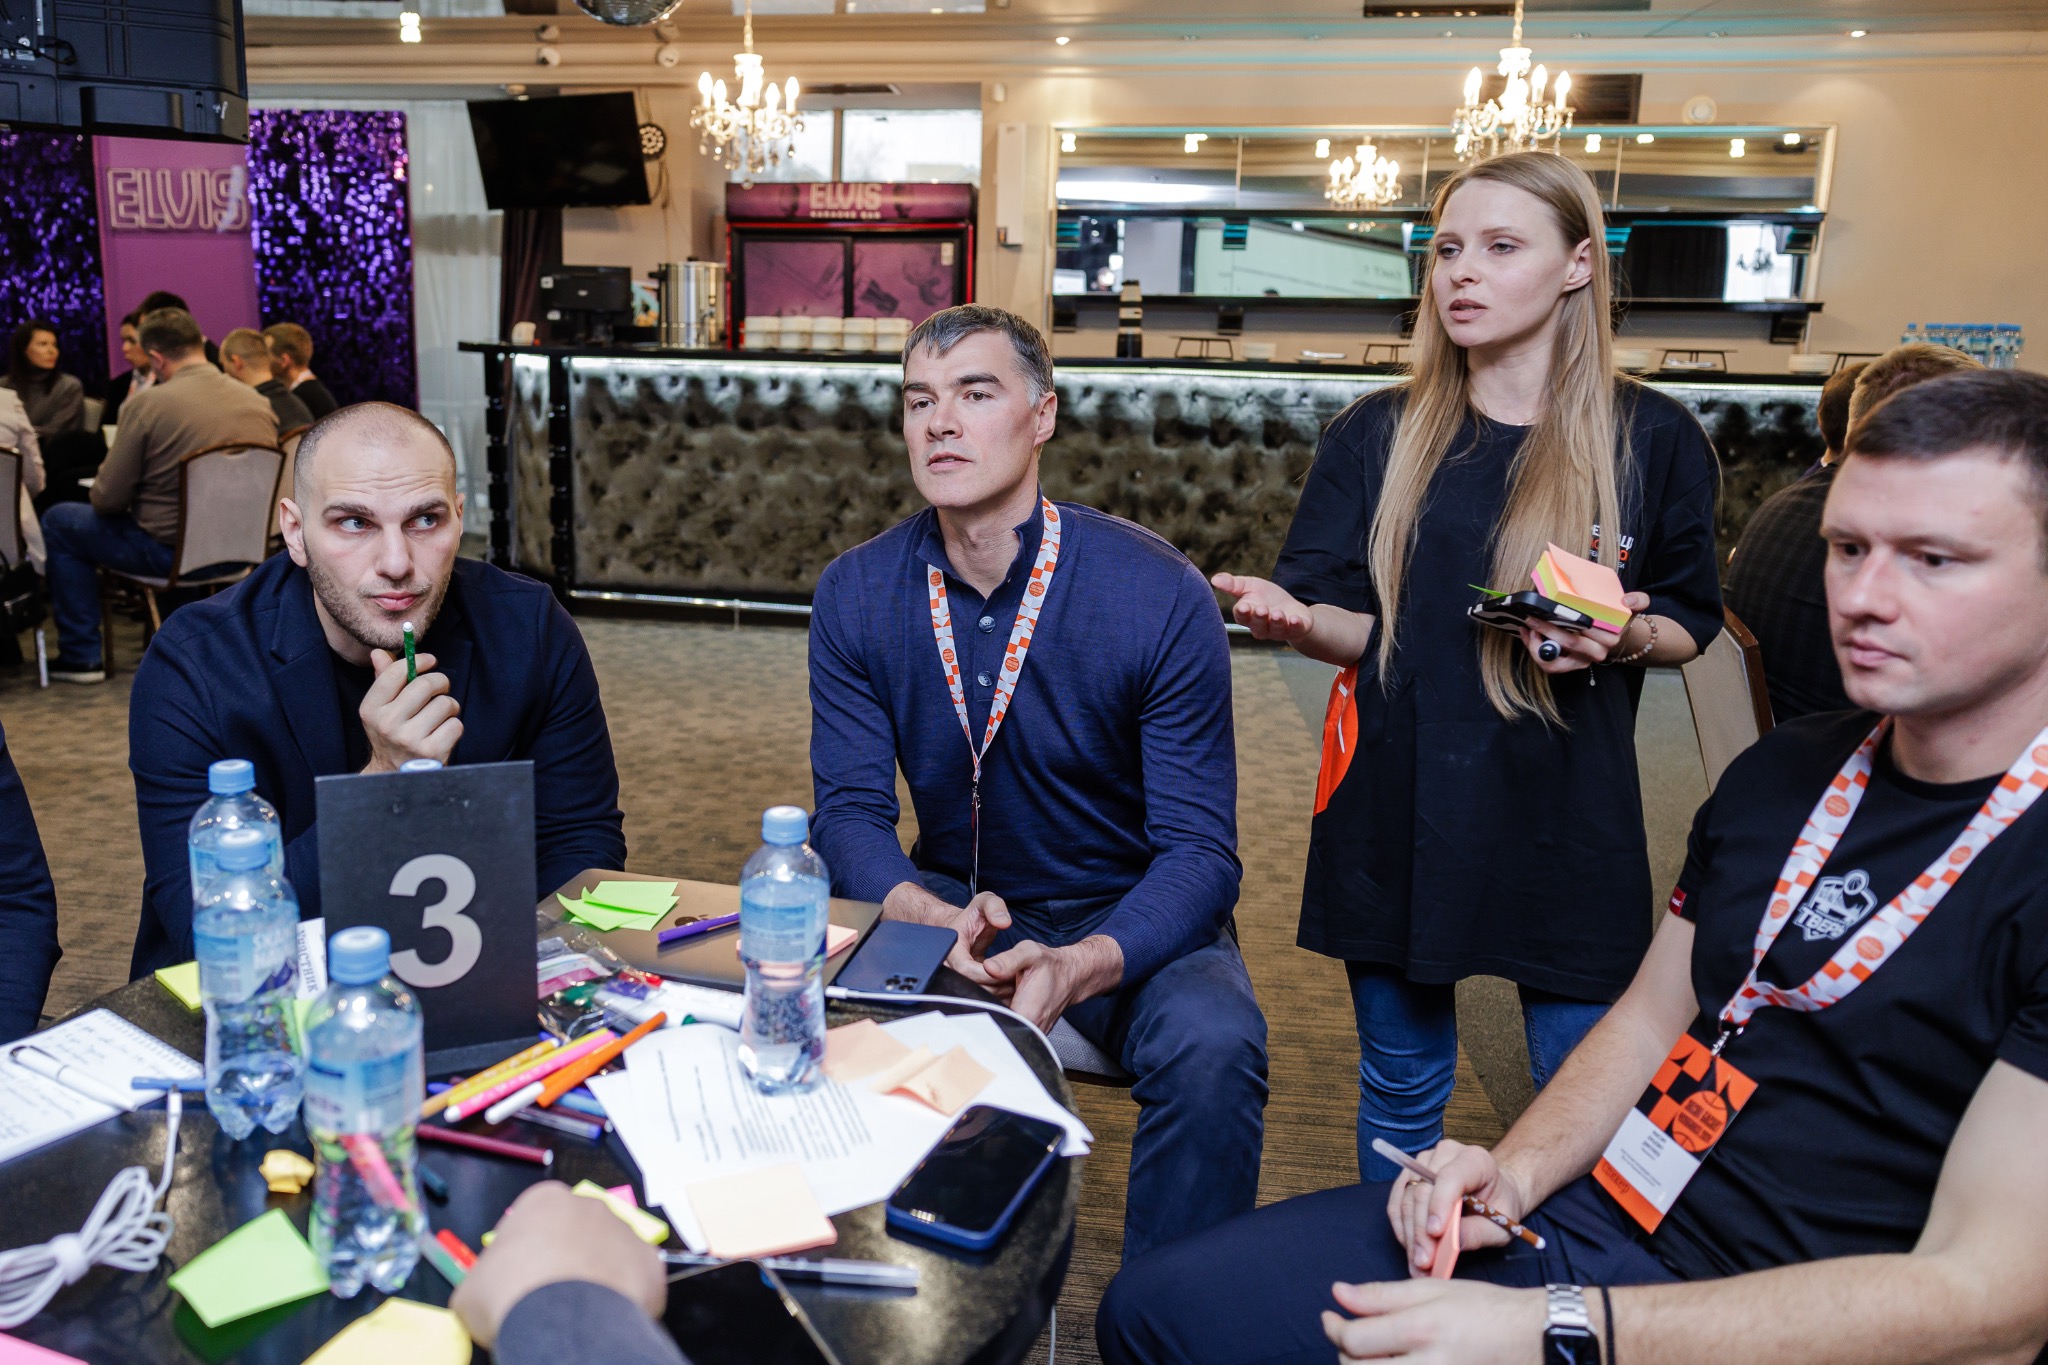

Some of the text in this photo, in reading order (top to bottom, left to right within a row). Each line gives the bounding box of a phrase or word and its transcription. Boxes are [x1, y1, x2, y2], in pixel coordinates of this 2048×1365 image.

[107, 167, 247, 230] ELVIS
[809, 183, 882, 210] ELVIS
[388, 853, 482, 988] 3
